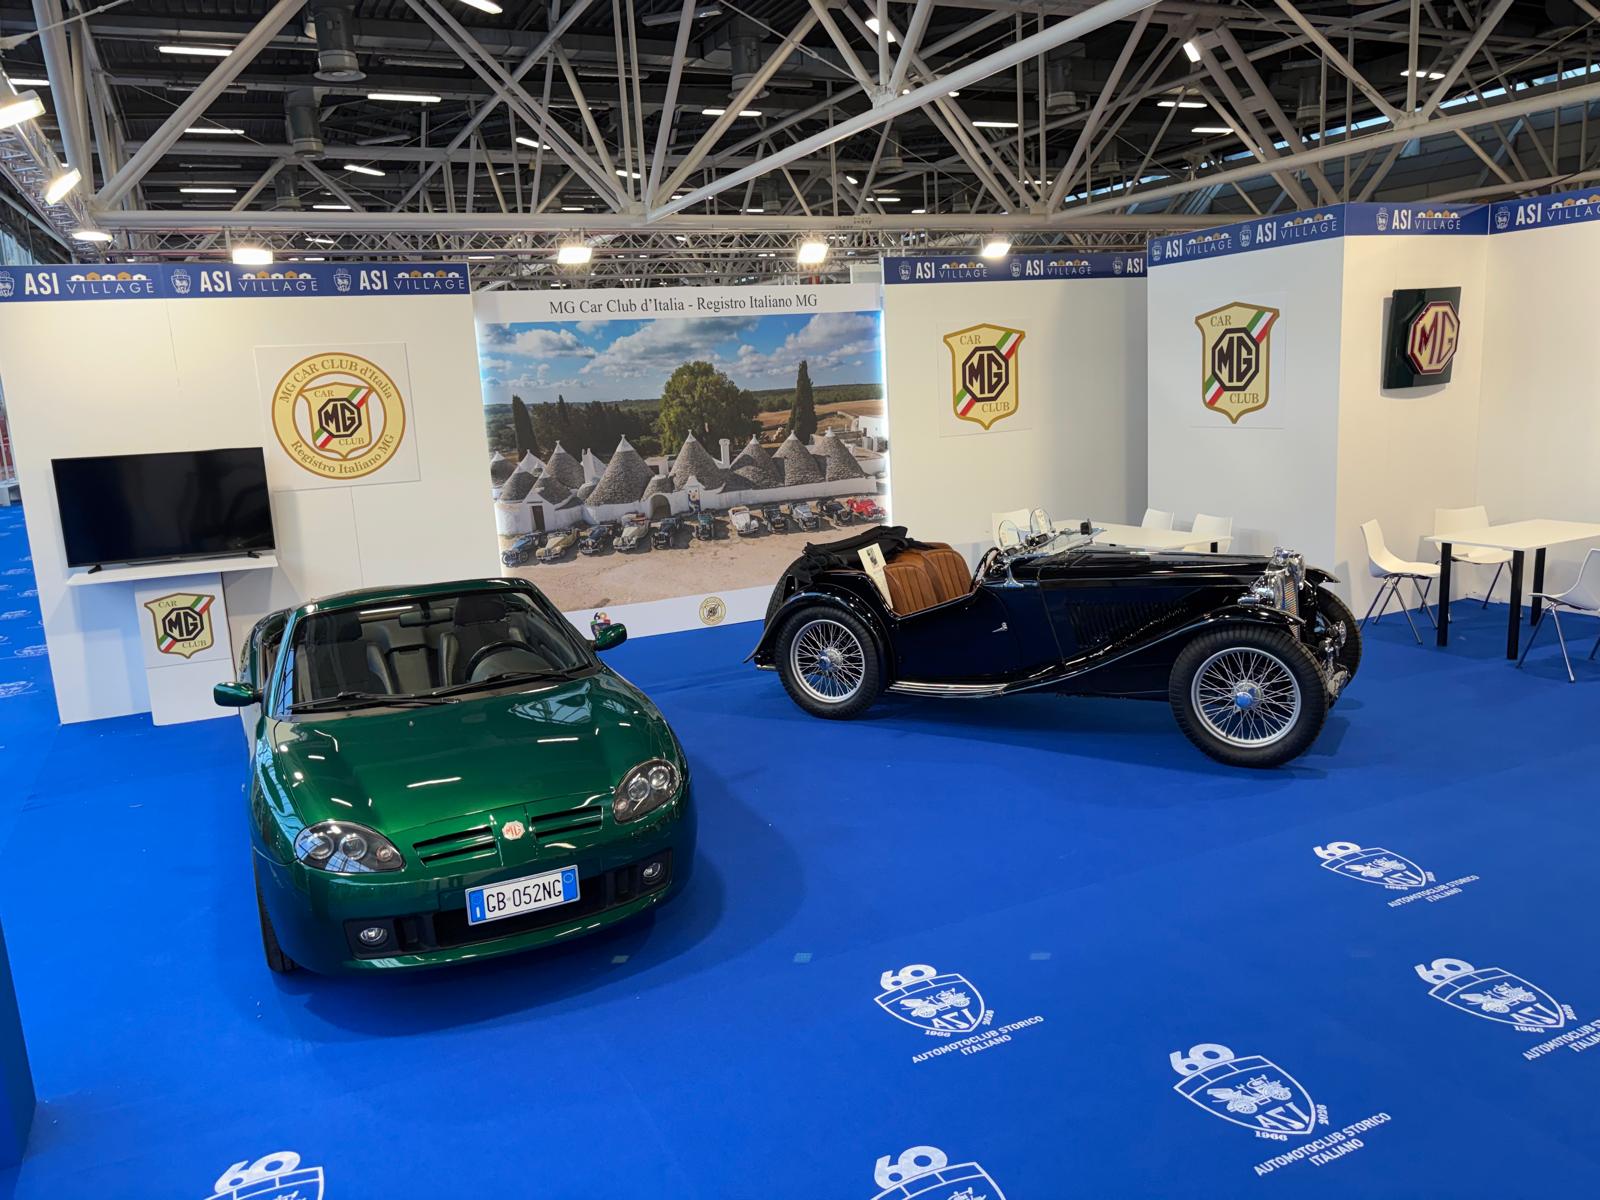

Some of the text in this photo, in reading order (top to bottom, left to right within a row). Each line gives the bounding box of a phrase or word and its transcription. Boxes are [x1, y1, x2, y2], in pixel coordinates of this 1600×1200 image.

[1392, 209, 1461, 230] ASI VILLAGE
[1515, 203, 1542, 226] ASI
[1256, 221, 1337, 244] ASI VILLAGE
[1165, 239, 1232, 259] ASI VILLAGE
[915, 262, 988, 279] ASI VILLAGE
[1025, 259, 1092, 276] ASI VILLAGE
[1126, 258, 1143, 274] ASI
[25, 272, 154, 295] ASI VILLAGE
[200, 271, 318, 292] ASI VILLAGE
[359, 270, 465, 291] ASI VILLAGE
[549, 301, 575, 314] MG
[579, 300, 603, 314] Car
[606, 299, 637, 313] Club
[697, 297, 746, 313] Registro
[749, 295, 793, 309] Italiano
[796, 294, 818, 307] MG
[1210, 315, 1232, 327] CAR
[959, 335, 982, 345] CAR
[1418, 311, 1455, 365] MG
[1217, 336, 1253, 383] MG
[280, 382, 296, 403] MG
[293, 363, 320, 383] CAR
[321, 359, 358, 372] CLUB
[968, 353, 1003, 395] MG
[314, 390, 335, 398] CAR
[1229, 393, 1259, 404] CLUB
[323, 402, 357, 433] MG
[981, 402, 1010, 413] CLUB
[338, 437, 365, 446] CLUB
[291, 434, 394, 474] Registro Italiano MG
[167, 611, 199, 637] MG
[505, 825, 521, 837] MG
[1313, 841, 1361, 859] 60
[486, 879, 562, 913] GB 052NG
[880, 964, 937, 991] 60
[1414, 958, 1474, 985] 60
[911, 1030, 999, 1064] AUTOMOTOCLUB
[998, 1015, 1044, 1035] STORICO
[960, 1034, 1012, 1056] ITALIANO
[1523, 1025, 1596, 1060] AUTOMOTOCLUB
[1169, 1043, 1235, 1077] 60
[1253, 1112, 1392, 1176] AUTOMOTOCLUB STORICO
[1308, 1138, 1365, 1167] ITALIANO
[215, 1151, 301, 1193] 60
[874, 1145, 948, 1190] 60
